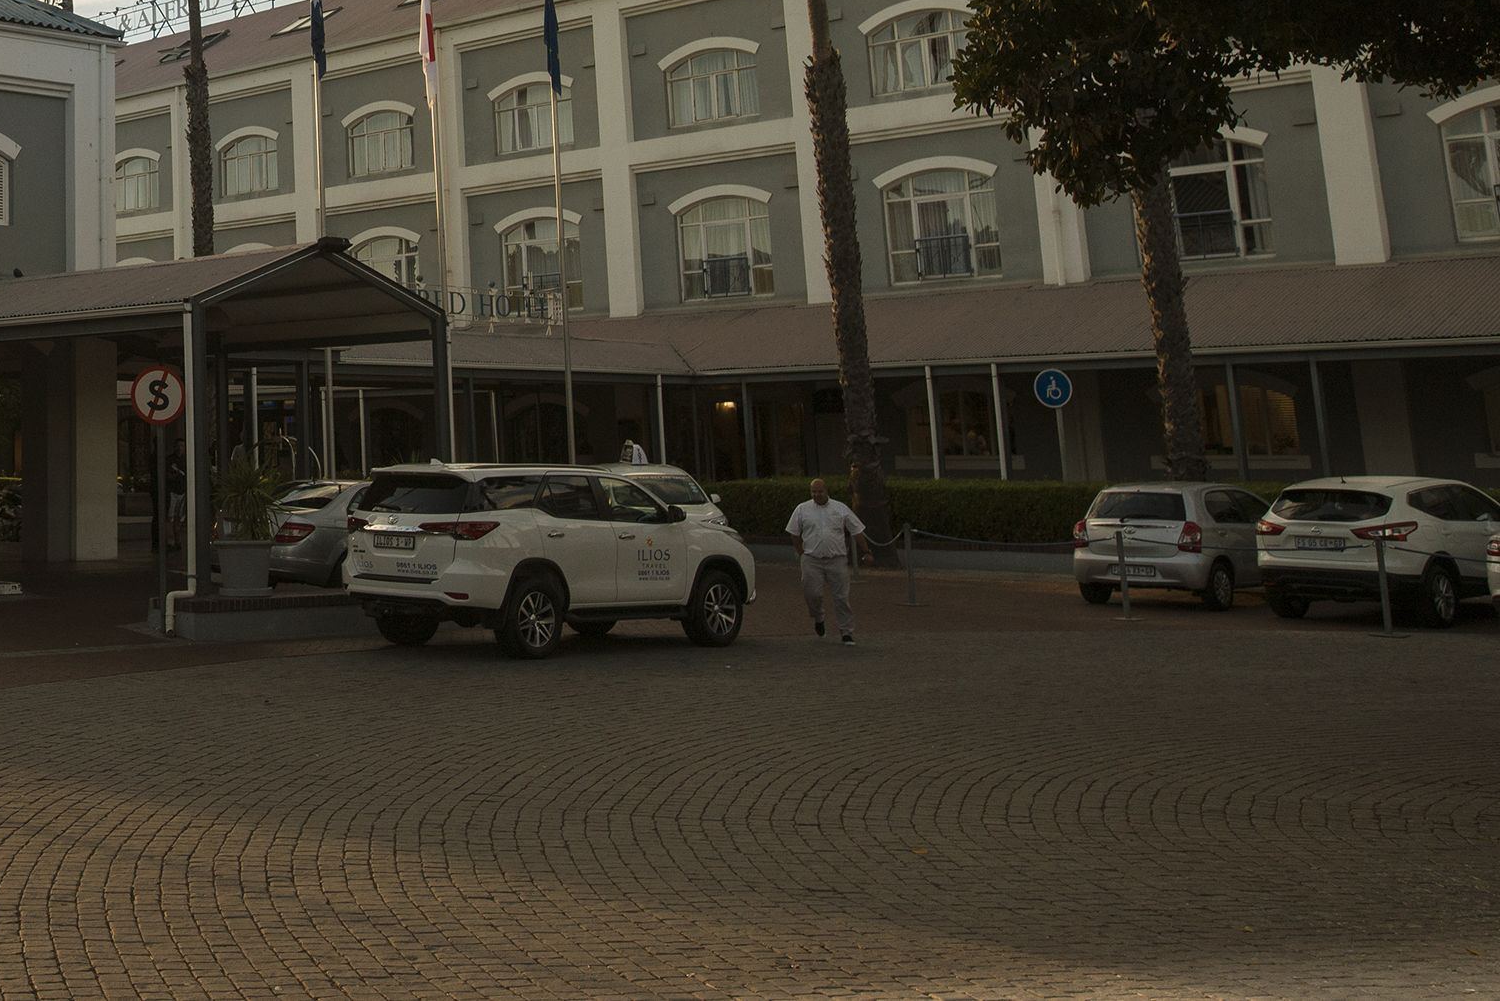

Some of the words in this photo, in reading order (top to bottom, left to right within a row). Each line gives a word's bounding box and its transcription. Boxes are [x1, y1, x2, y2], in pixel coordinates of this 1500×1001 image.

[118, 13, 133, 32] &
[479, 294, 554, 321] HOTEL
[147, 380, 169, 411] S
[637, 548, 671, 561] ILIOS
